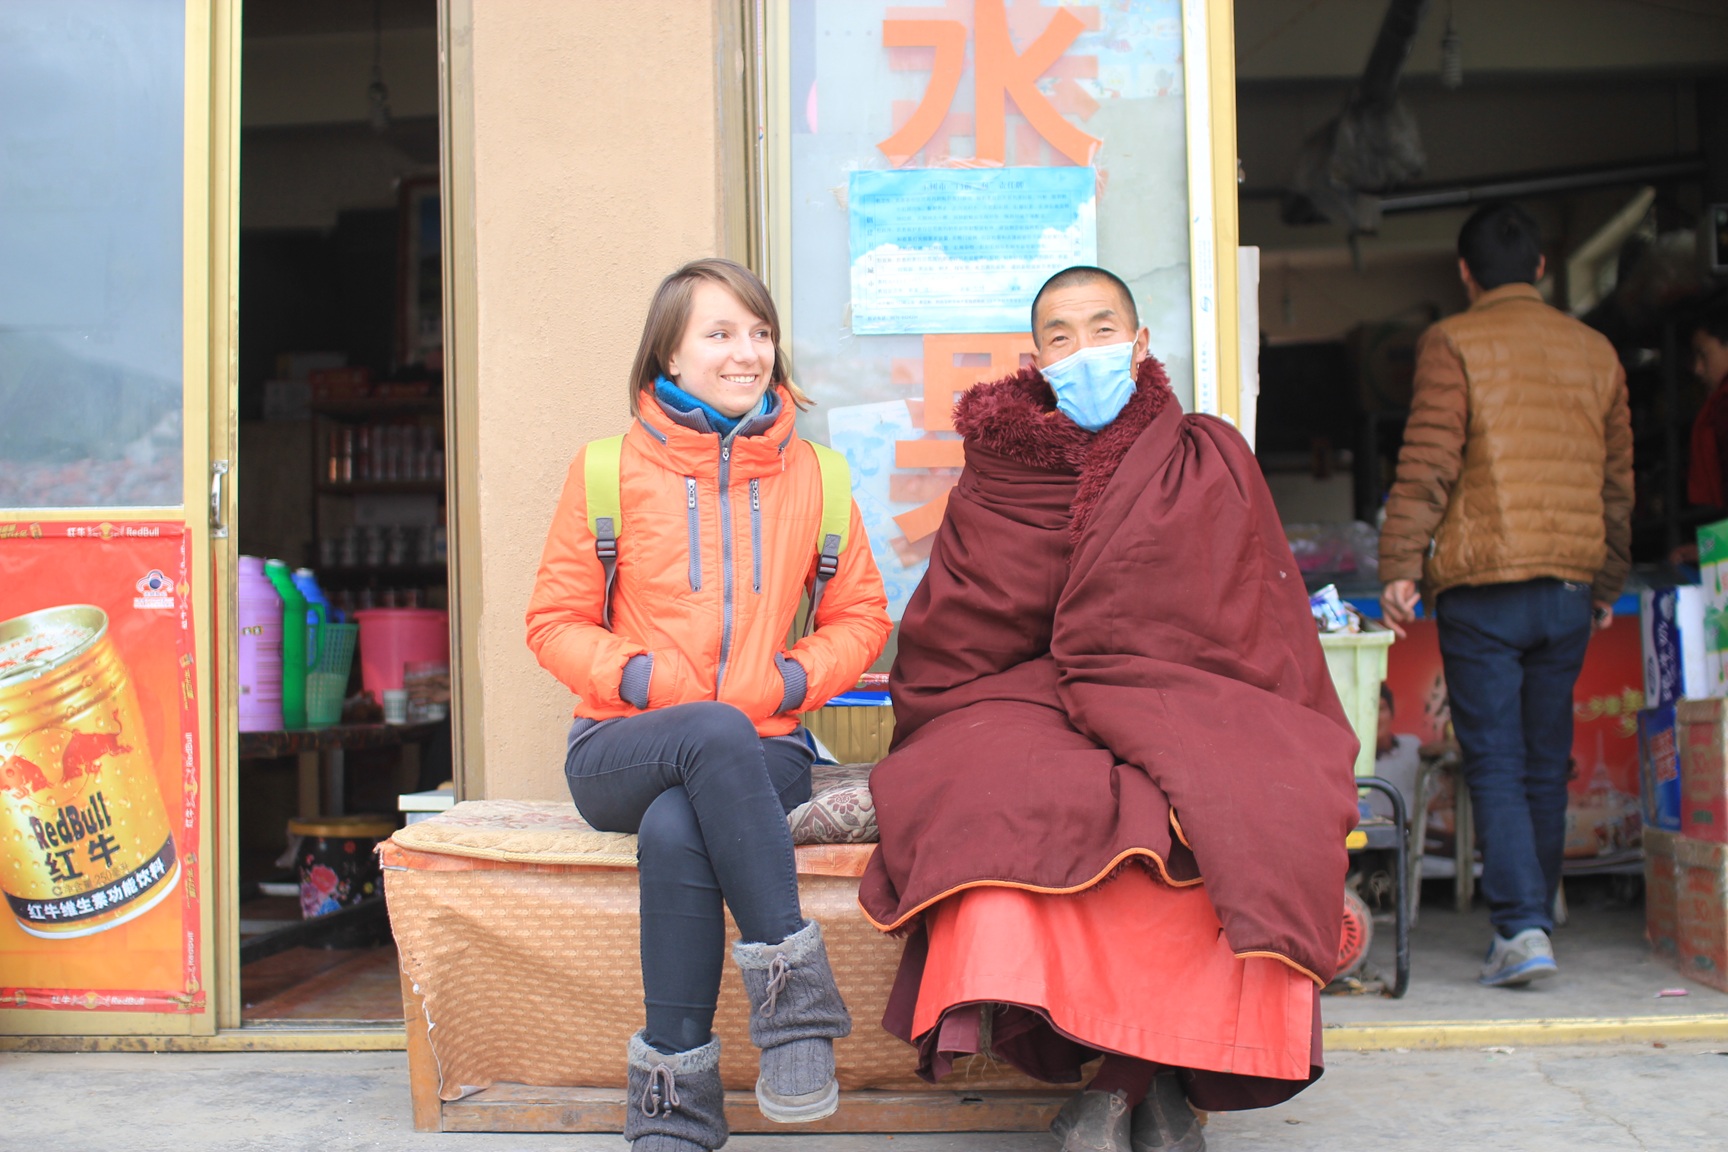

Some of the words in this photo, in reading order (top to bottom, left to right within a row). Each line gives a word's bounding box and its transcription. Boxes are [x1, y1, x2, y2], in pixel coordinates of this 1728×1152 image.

[126, 526, 160, 538] RedBull
[29, 791, 112, 850] RedBull
[45, 834, 120, 883] 红牛
[27, 856, 166, 920] 红牛维生素功能饮料
